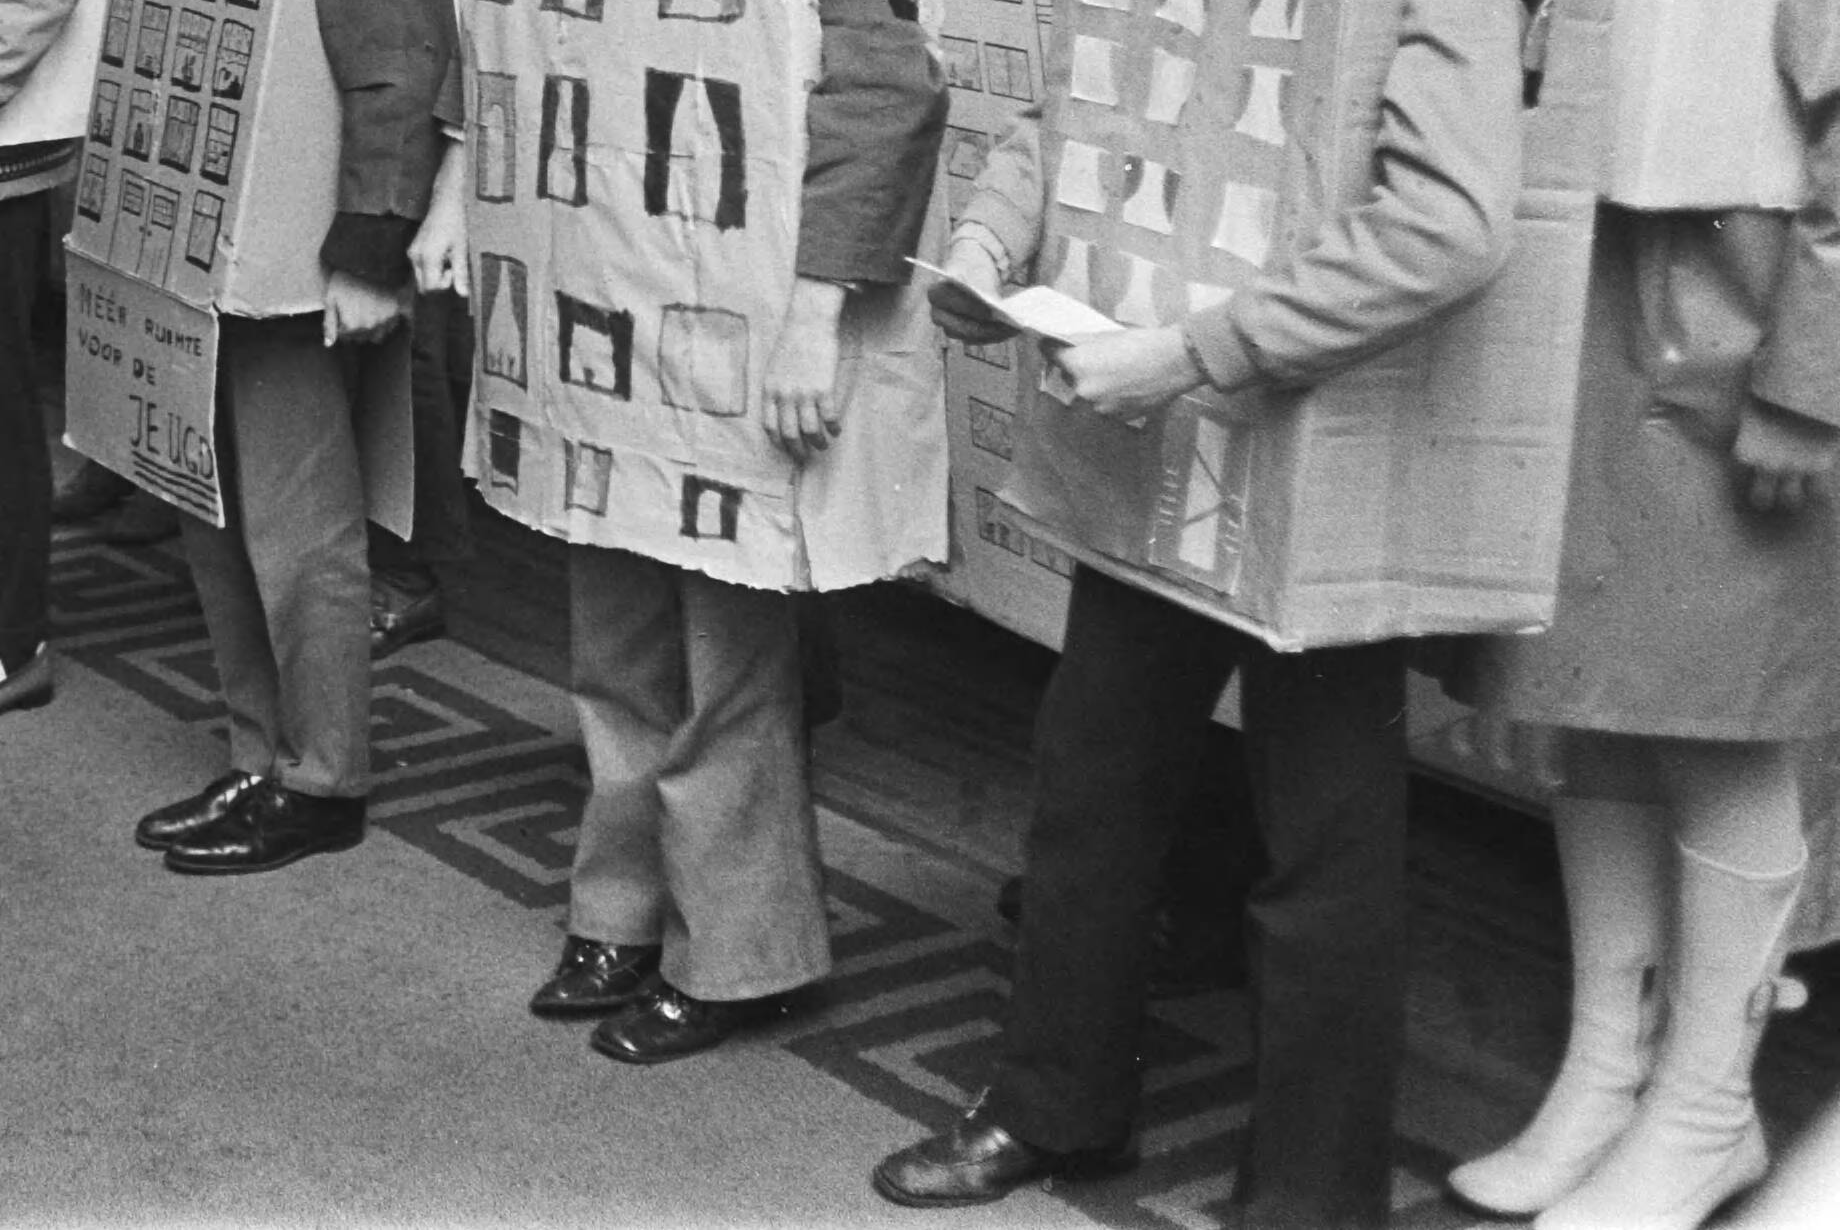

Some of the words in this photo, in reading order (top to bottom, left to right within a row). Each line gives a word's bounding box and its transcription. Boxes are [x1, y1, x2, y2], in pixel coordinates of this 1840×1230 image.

[79, 327, 122, 365] VOOR
[133, 358, 156, 386] DE
[129, 394, 214, 480] JEUGD
